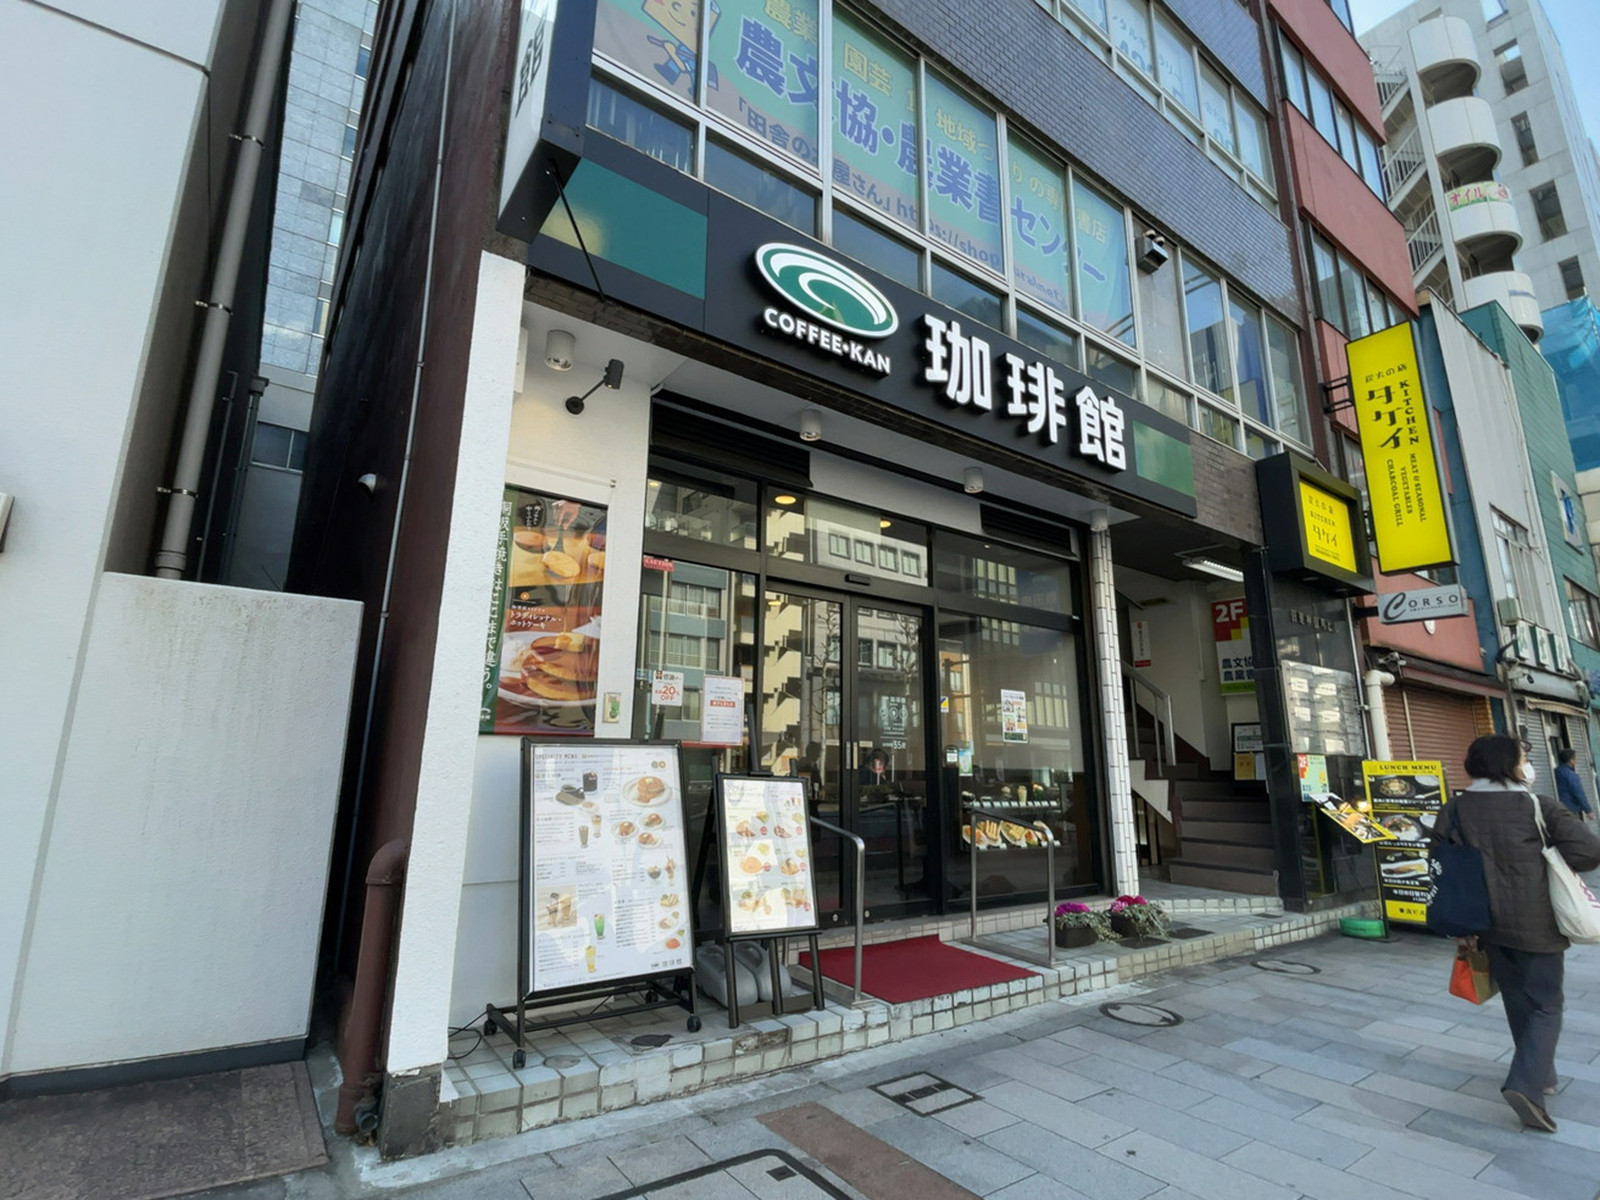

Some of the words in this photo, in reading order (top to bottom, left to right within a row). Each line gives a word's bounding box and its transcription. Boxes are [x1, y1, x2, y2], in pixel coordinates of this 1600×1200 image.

[843, 42, 894, 97] 園芸
[738, 95, 891, 212] 「田舎の屋さん」
[923, 313, 1128, 473] 珈琲館
[1399, 379, 1420, 446] KITCHEN
[1409, 452, 1420, 474] MEAT
[1386, 458, 1400, 502] CHARCOAL
[1393, 502, 1404, 528] GRILL
[1400, 466, 1414, 515] VEGETABLES
[1414, 482, 1427, 523] SEASONAL
[1214, 601, 1244, 624] 2F
[1383, 591, 1459, 621] CORSO
